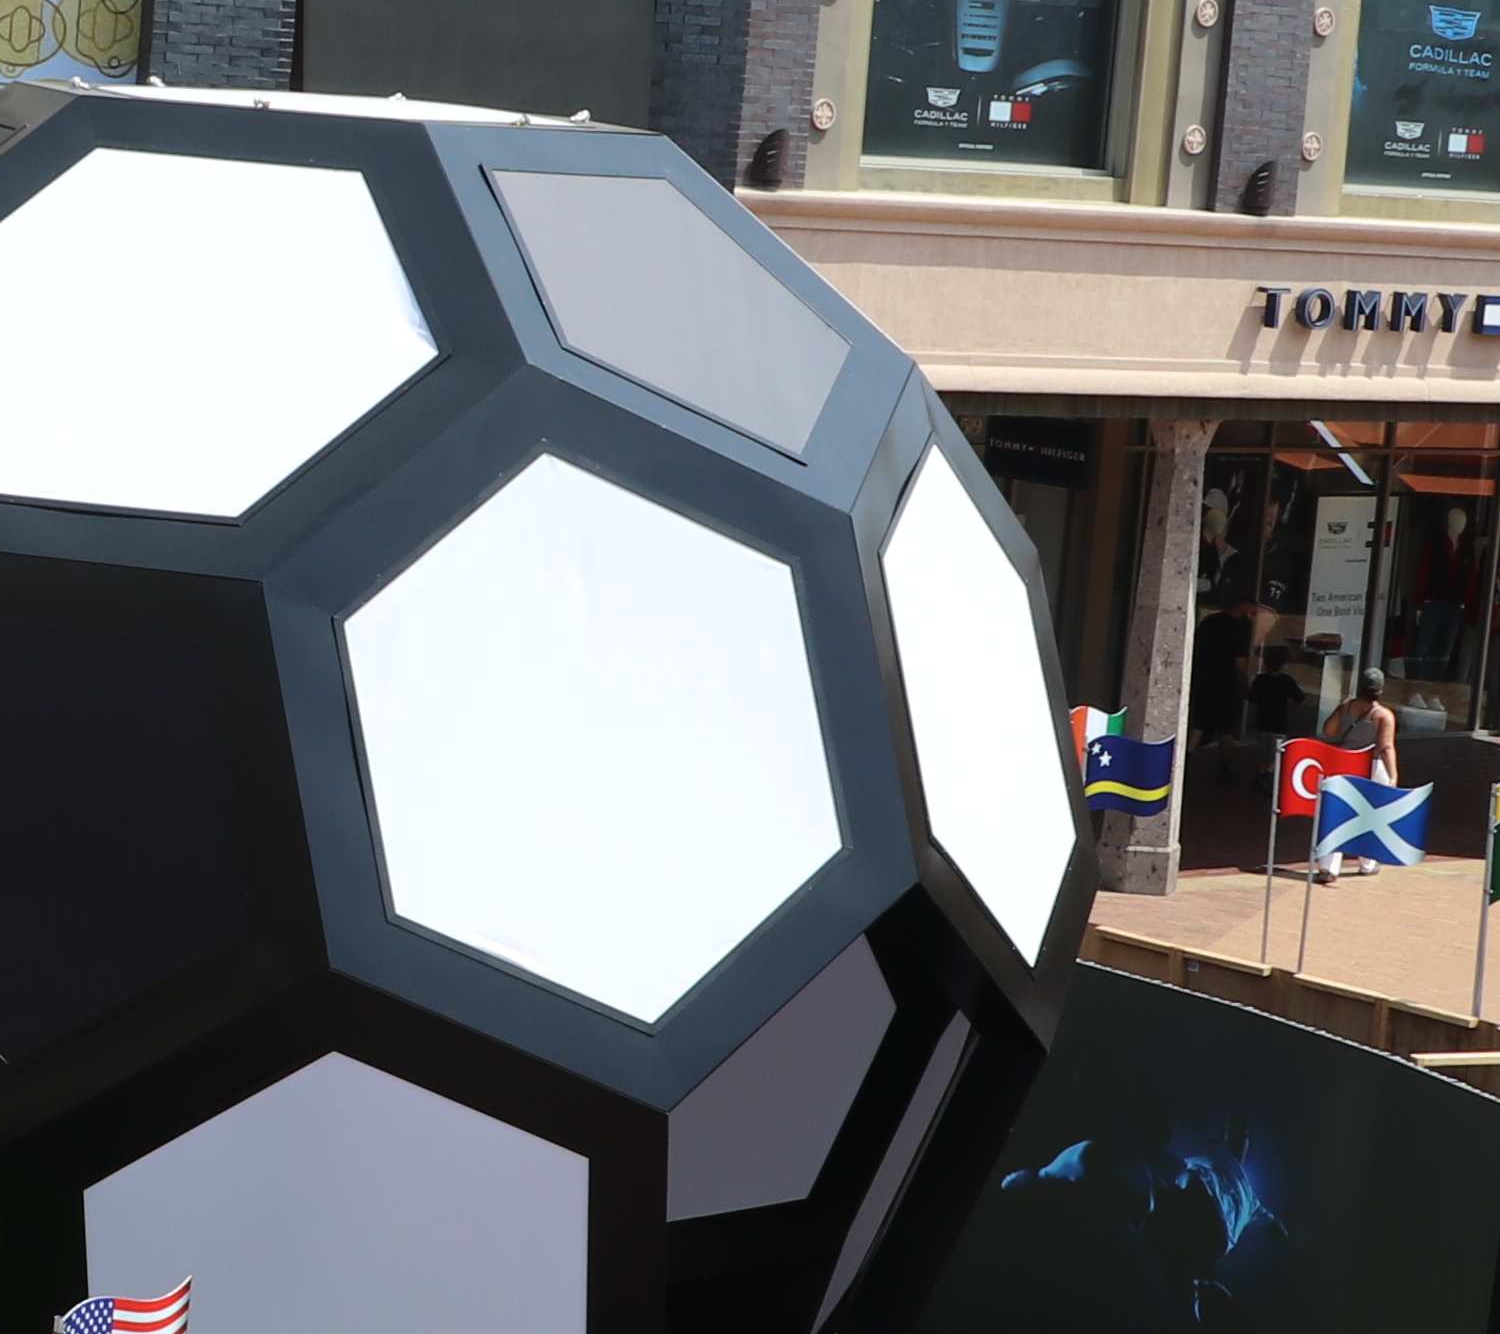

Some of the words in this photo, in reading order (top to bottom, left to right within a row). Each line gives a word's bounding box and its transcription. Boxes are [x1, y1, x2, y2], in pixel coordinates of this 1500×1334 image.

[1409, 44, 1493, 67] CADILLAC
[1408, 62, 1454, 76] FORMULA
[1464, 68, 1491, 80] TEAM
[913, 108, 969, 122] CADILLAC
[990, 122, 1028, 130] HILFIGER
[1384, 141, 1431, 153] CADILLAC
[1255, 286, 1468, 334] TOMMY
[988, 437, 1028, 452] TOMMY
[1040, 447, 1087, 463] HILFIGER
[1311, 592, 1326, 603] Two
[1328, 591, 1363, 604] American
[1316, 606, 1332, 617] One
[1334, 605, 1352, 617] Bold
